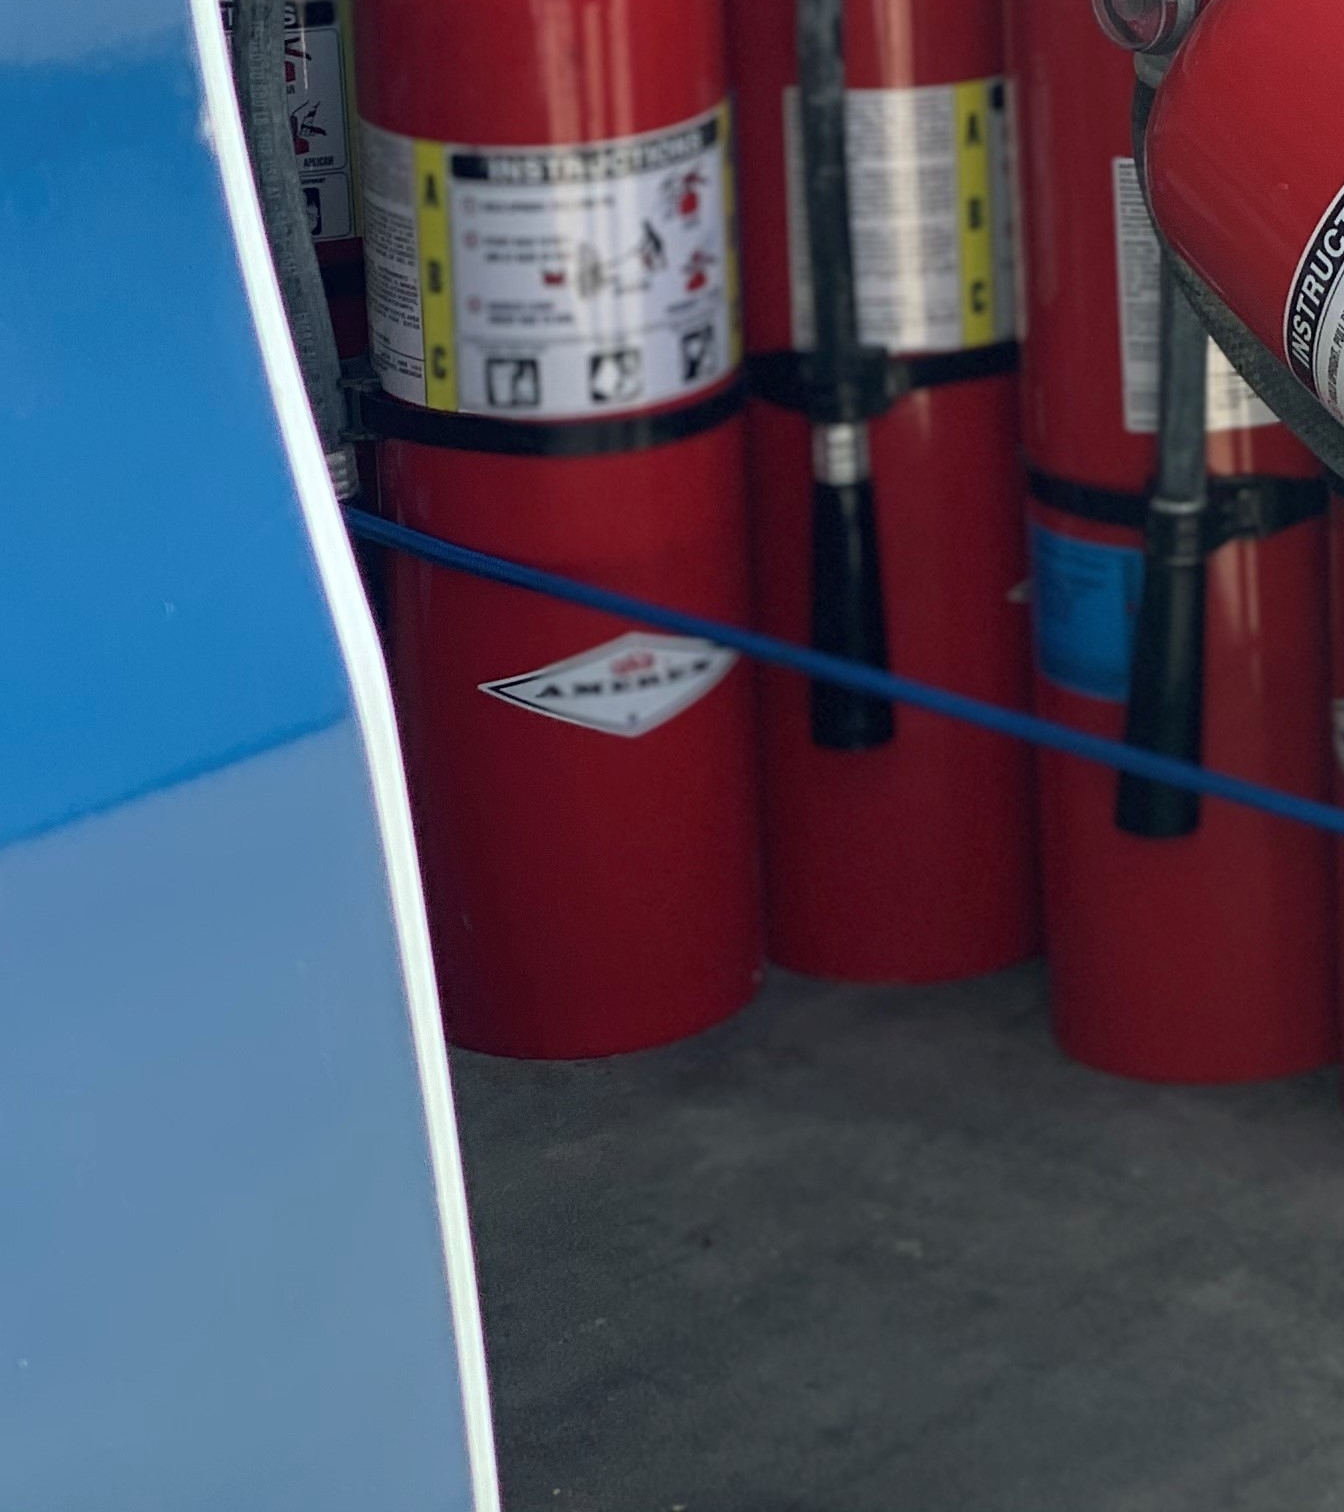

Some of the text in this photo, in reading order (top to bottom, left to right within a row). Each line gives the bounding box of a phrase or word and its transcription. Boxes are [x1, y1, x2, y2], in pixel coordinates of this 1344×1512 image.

[966, 113, 982, 145] A
[424, 175, 439, 206] A
[428, 261, 442, 294] B
[431, 346, 447, 379] C
